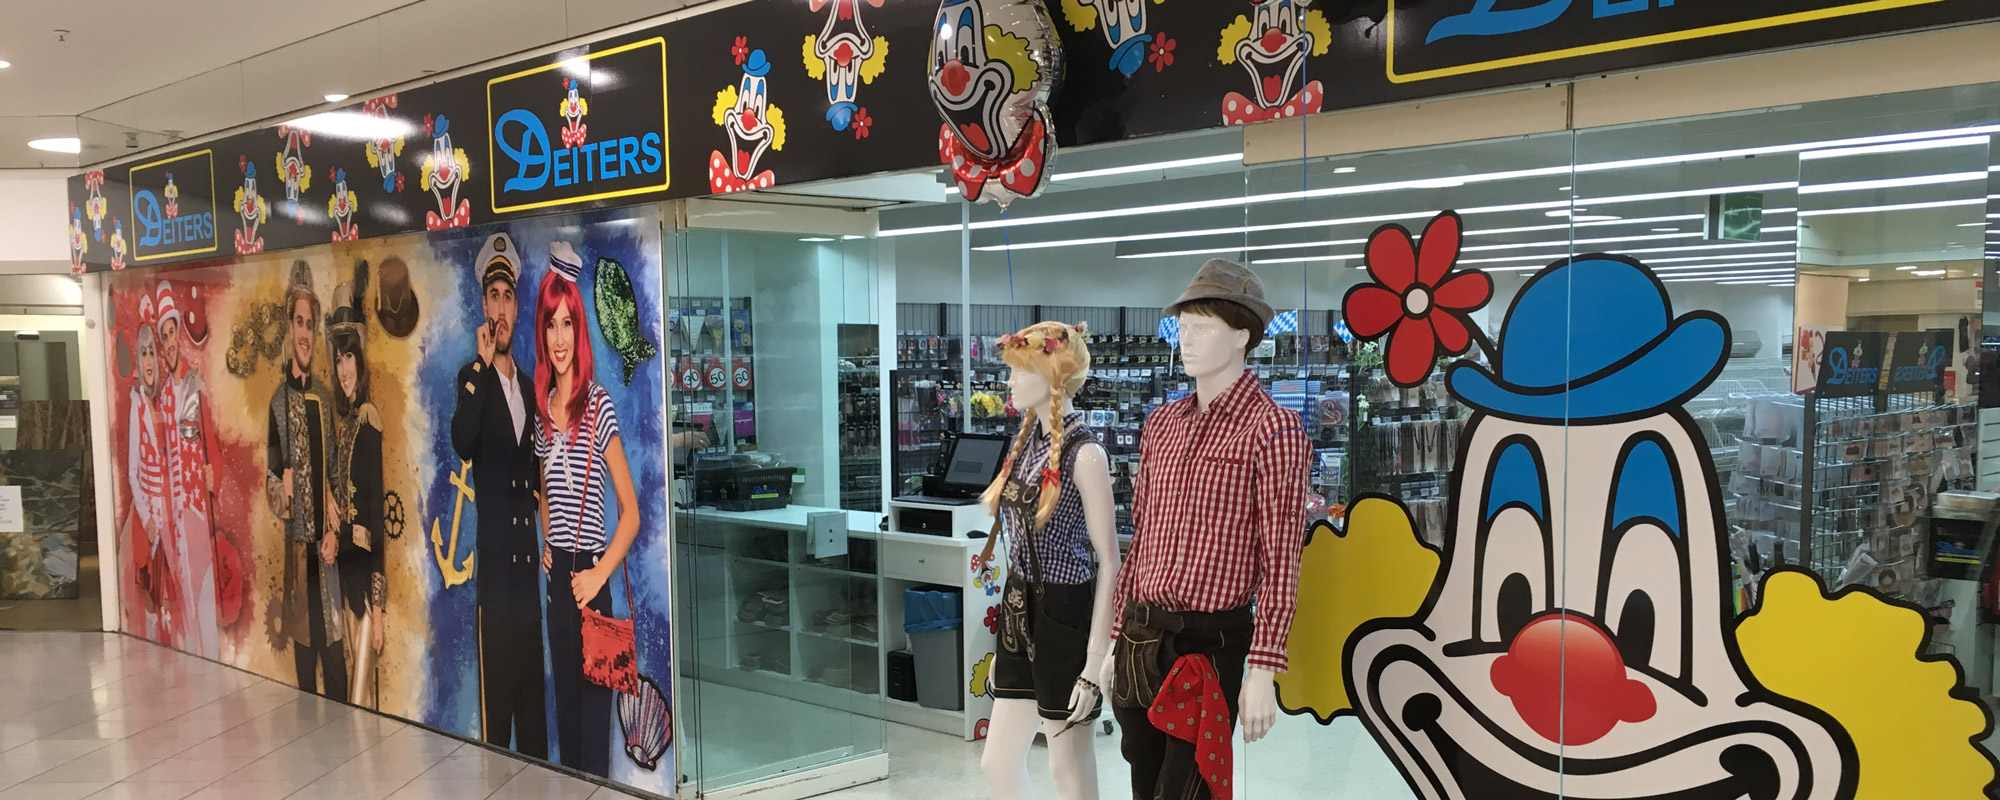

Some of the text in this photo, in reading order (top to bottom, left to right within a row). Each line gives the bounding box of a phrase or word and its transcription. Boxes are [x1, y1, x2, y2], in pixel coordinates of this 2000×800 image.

[495, 109, 662, 193] DEITERS
[133, 189, 213, 247] DEITERS
[684, 371, 699, 386] 30
[710, 370, 726, 385] 50
[735, 370, 749, 384] 60
